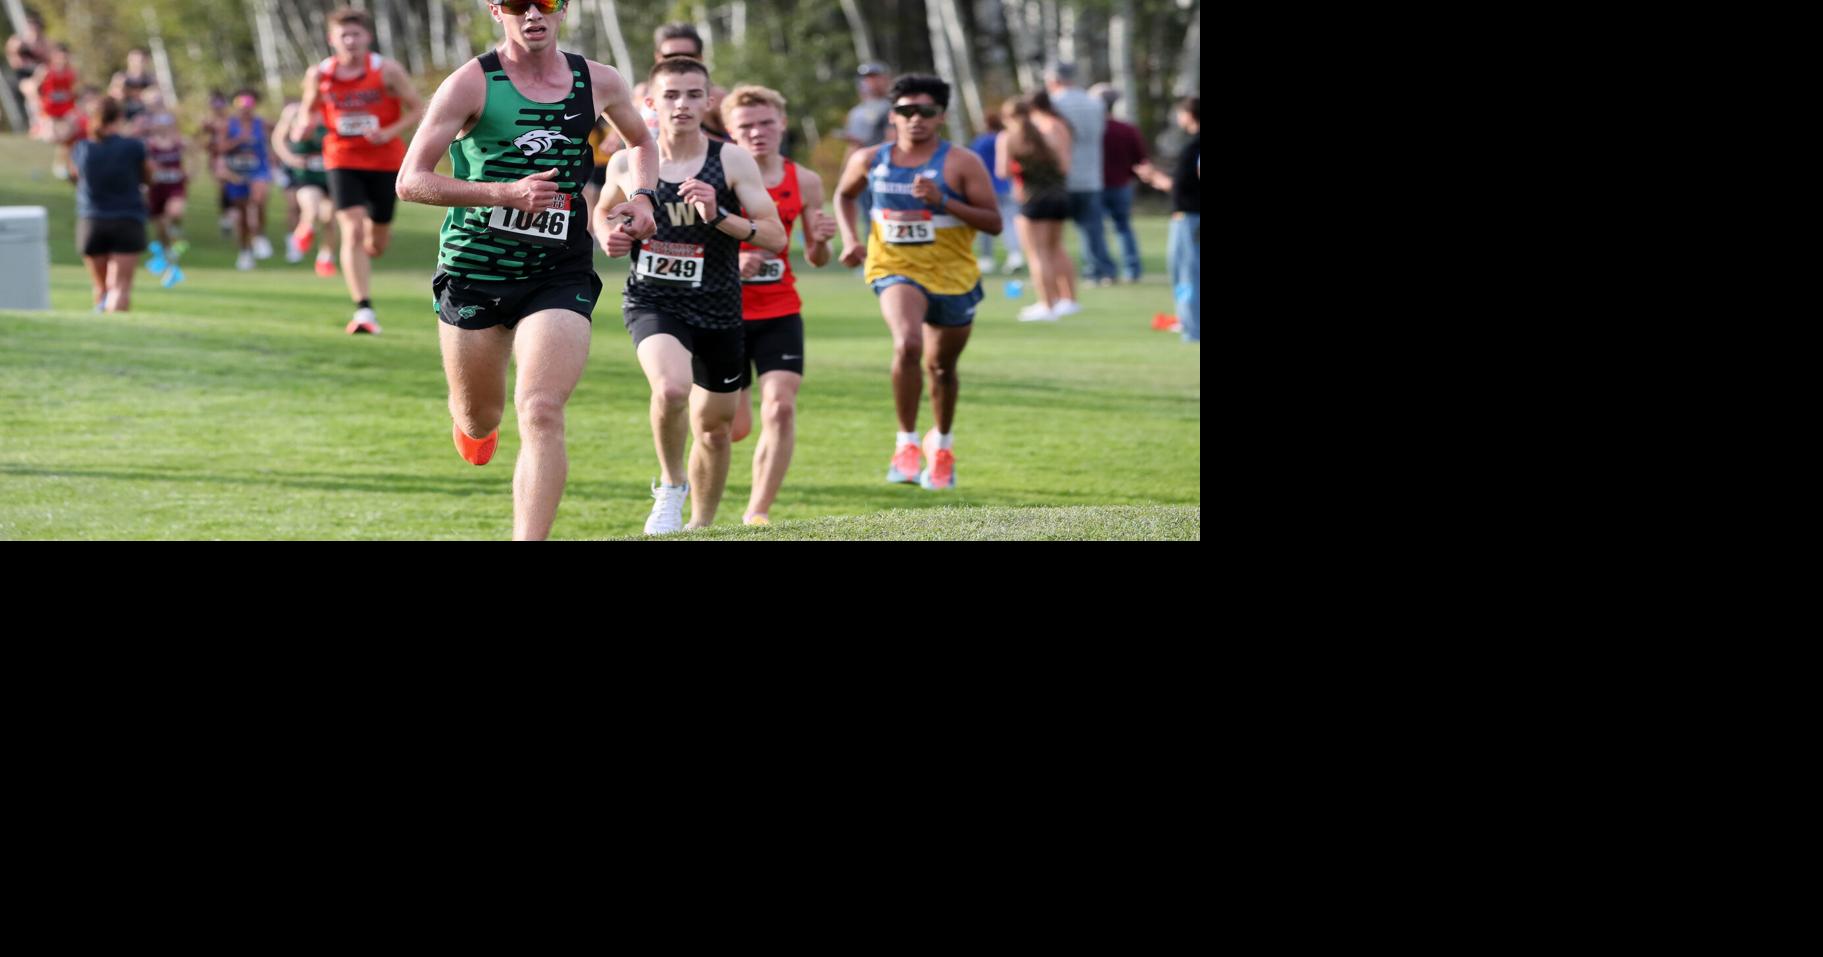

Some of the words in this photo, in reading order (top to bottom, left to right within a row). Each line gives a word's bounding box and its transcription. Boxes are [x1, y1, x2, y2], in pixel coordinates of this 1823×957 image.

[502, 207, 566, 235] 1046
[664, 201, 697, 227] W
[645, 255, 697, 278] 1249
